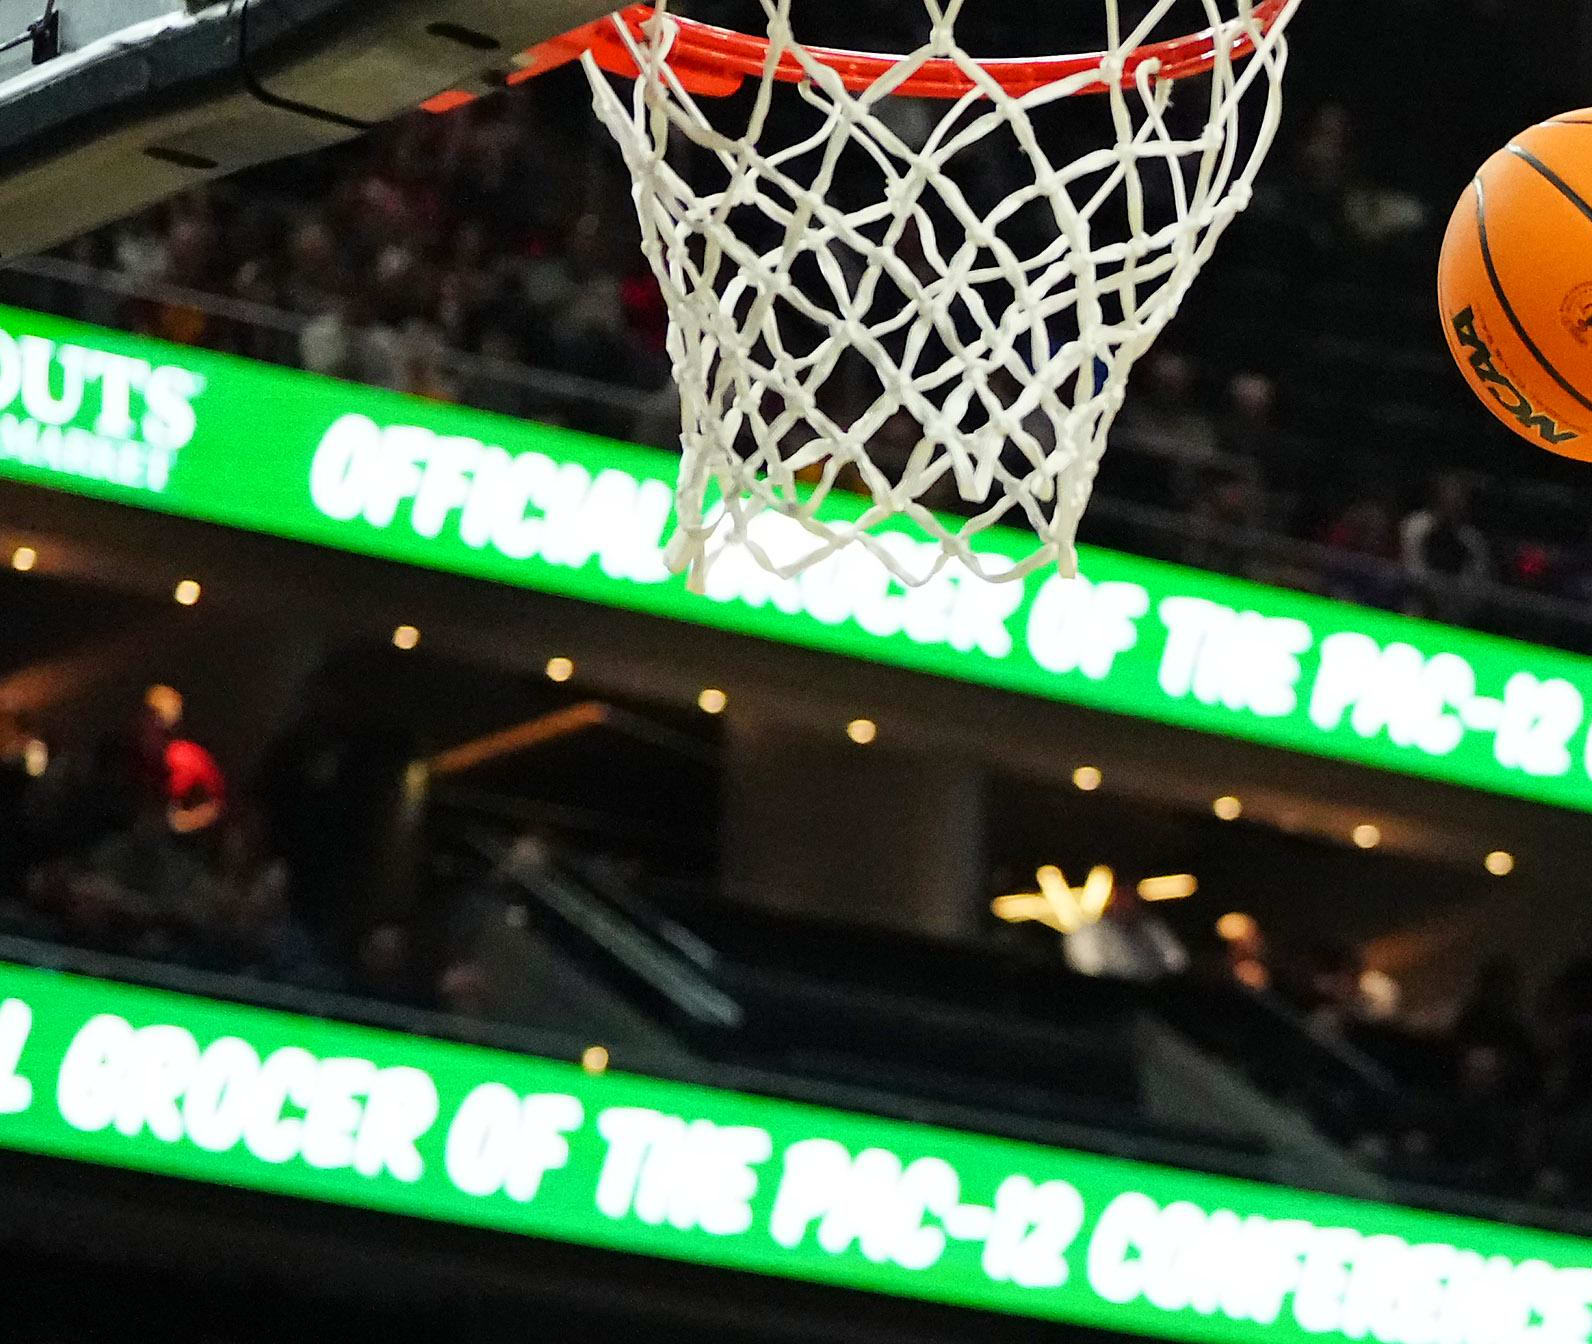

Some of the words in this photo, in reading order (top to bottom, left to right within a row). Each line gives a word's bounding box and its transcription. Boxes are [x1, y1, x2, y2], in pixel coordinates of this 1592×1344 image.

[1452, 304, 1579, 445] NCAA
[308, 413, 672, 583] OFFICIAL
[1026, 568, 1150, 679] OF
[1157, 595, 1313, 717] THE
[1309, 632, 1585, 776] PAC-12
[57, 1013, 440, 1182] GROCER
[445, 1082, 585, 1202] OF
[595, 1106, 774, 1235] THE
[770, 1138, 1085, 1288] PAC-12
